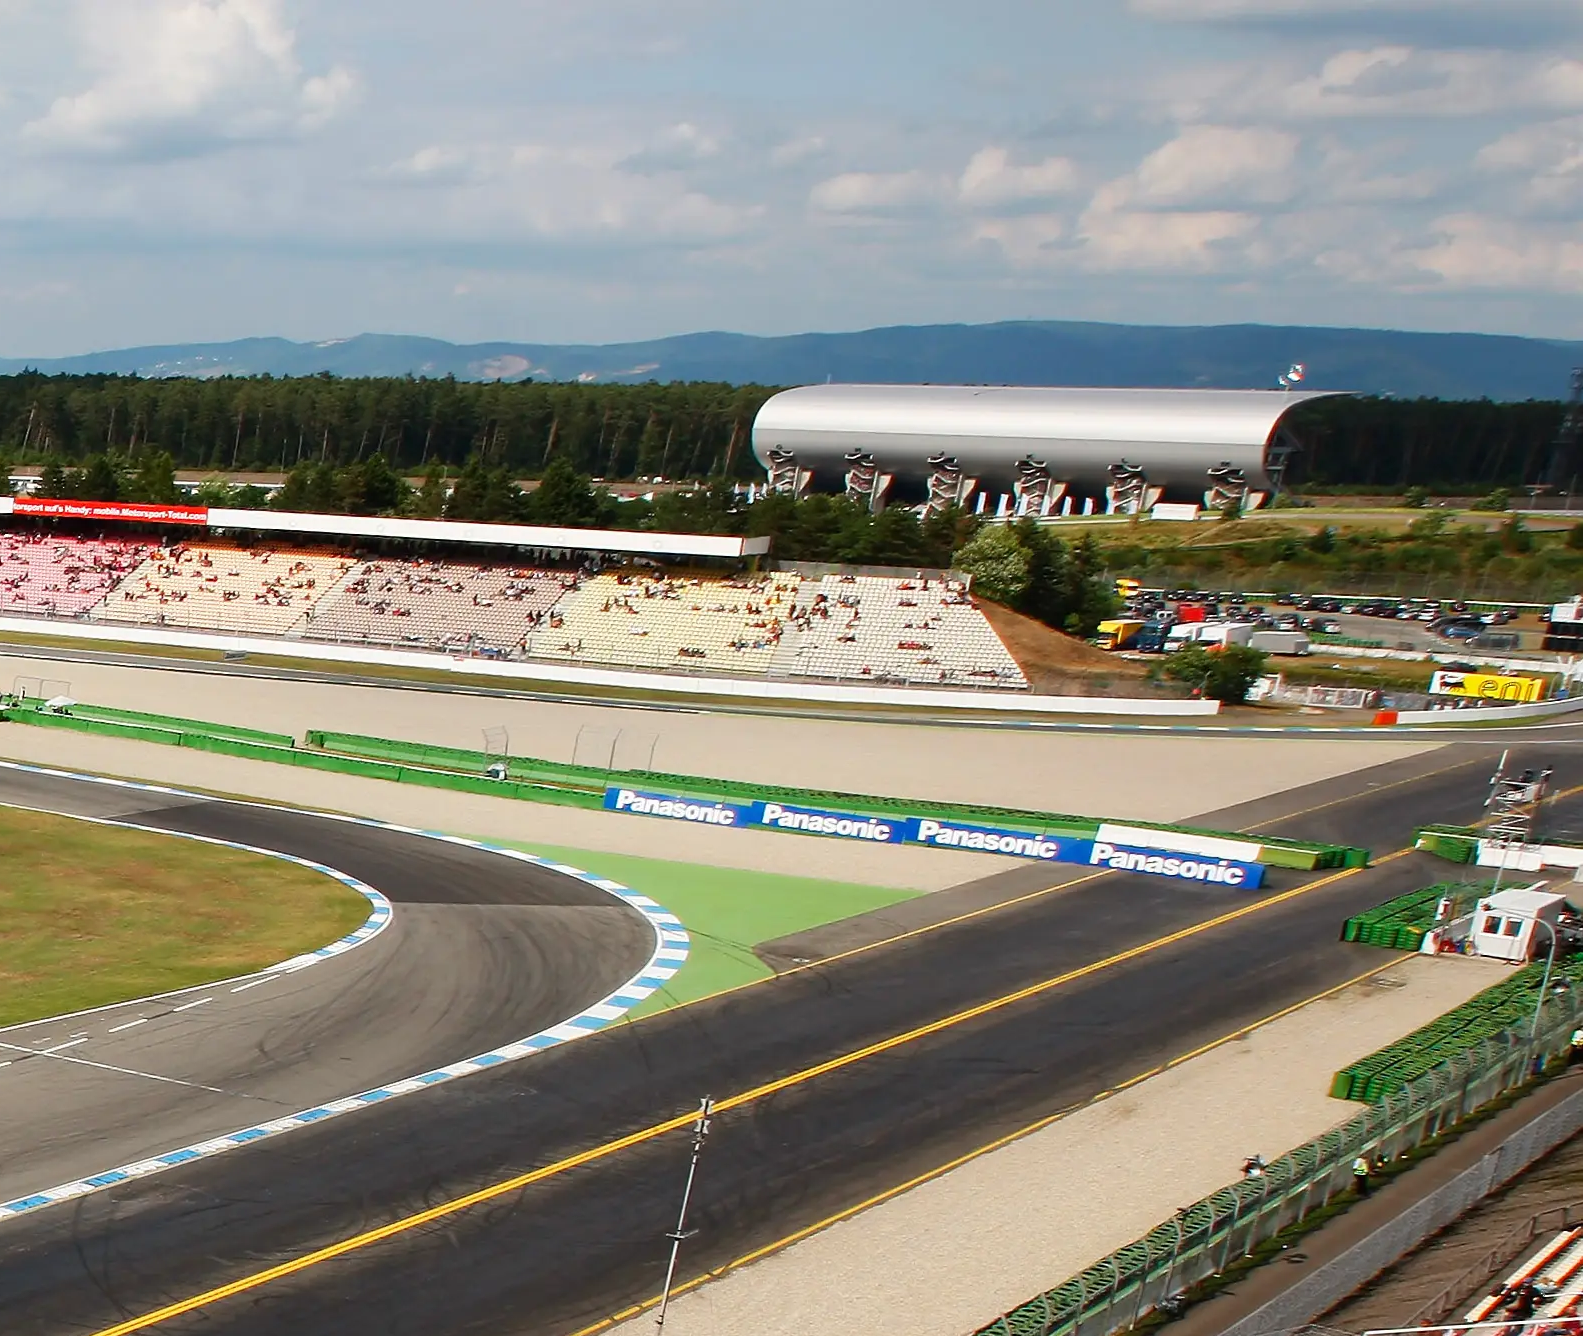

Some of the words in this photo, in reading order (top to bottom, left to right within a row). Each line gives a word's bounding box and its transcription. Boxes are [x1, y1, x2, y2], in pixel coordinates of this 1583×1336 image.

[1478, 677, 1537, 702] eni
[616, 788, 734, 826] Panasonic
[762, 803, 891, 841] Panasonic
[917, 820, 1058, 860] Panasonic
[1090, 842, 1244, 886] Panasonic
